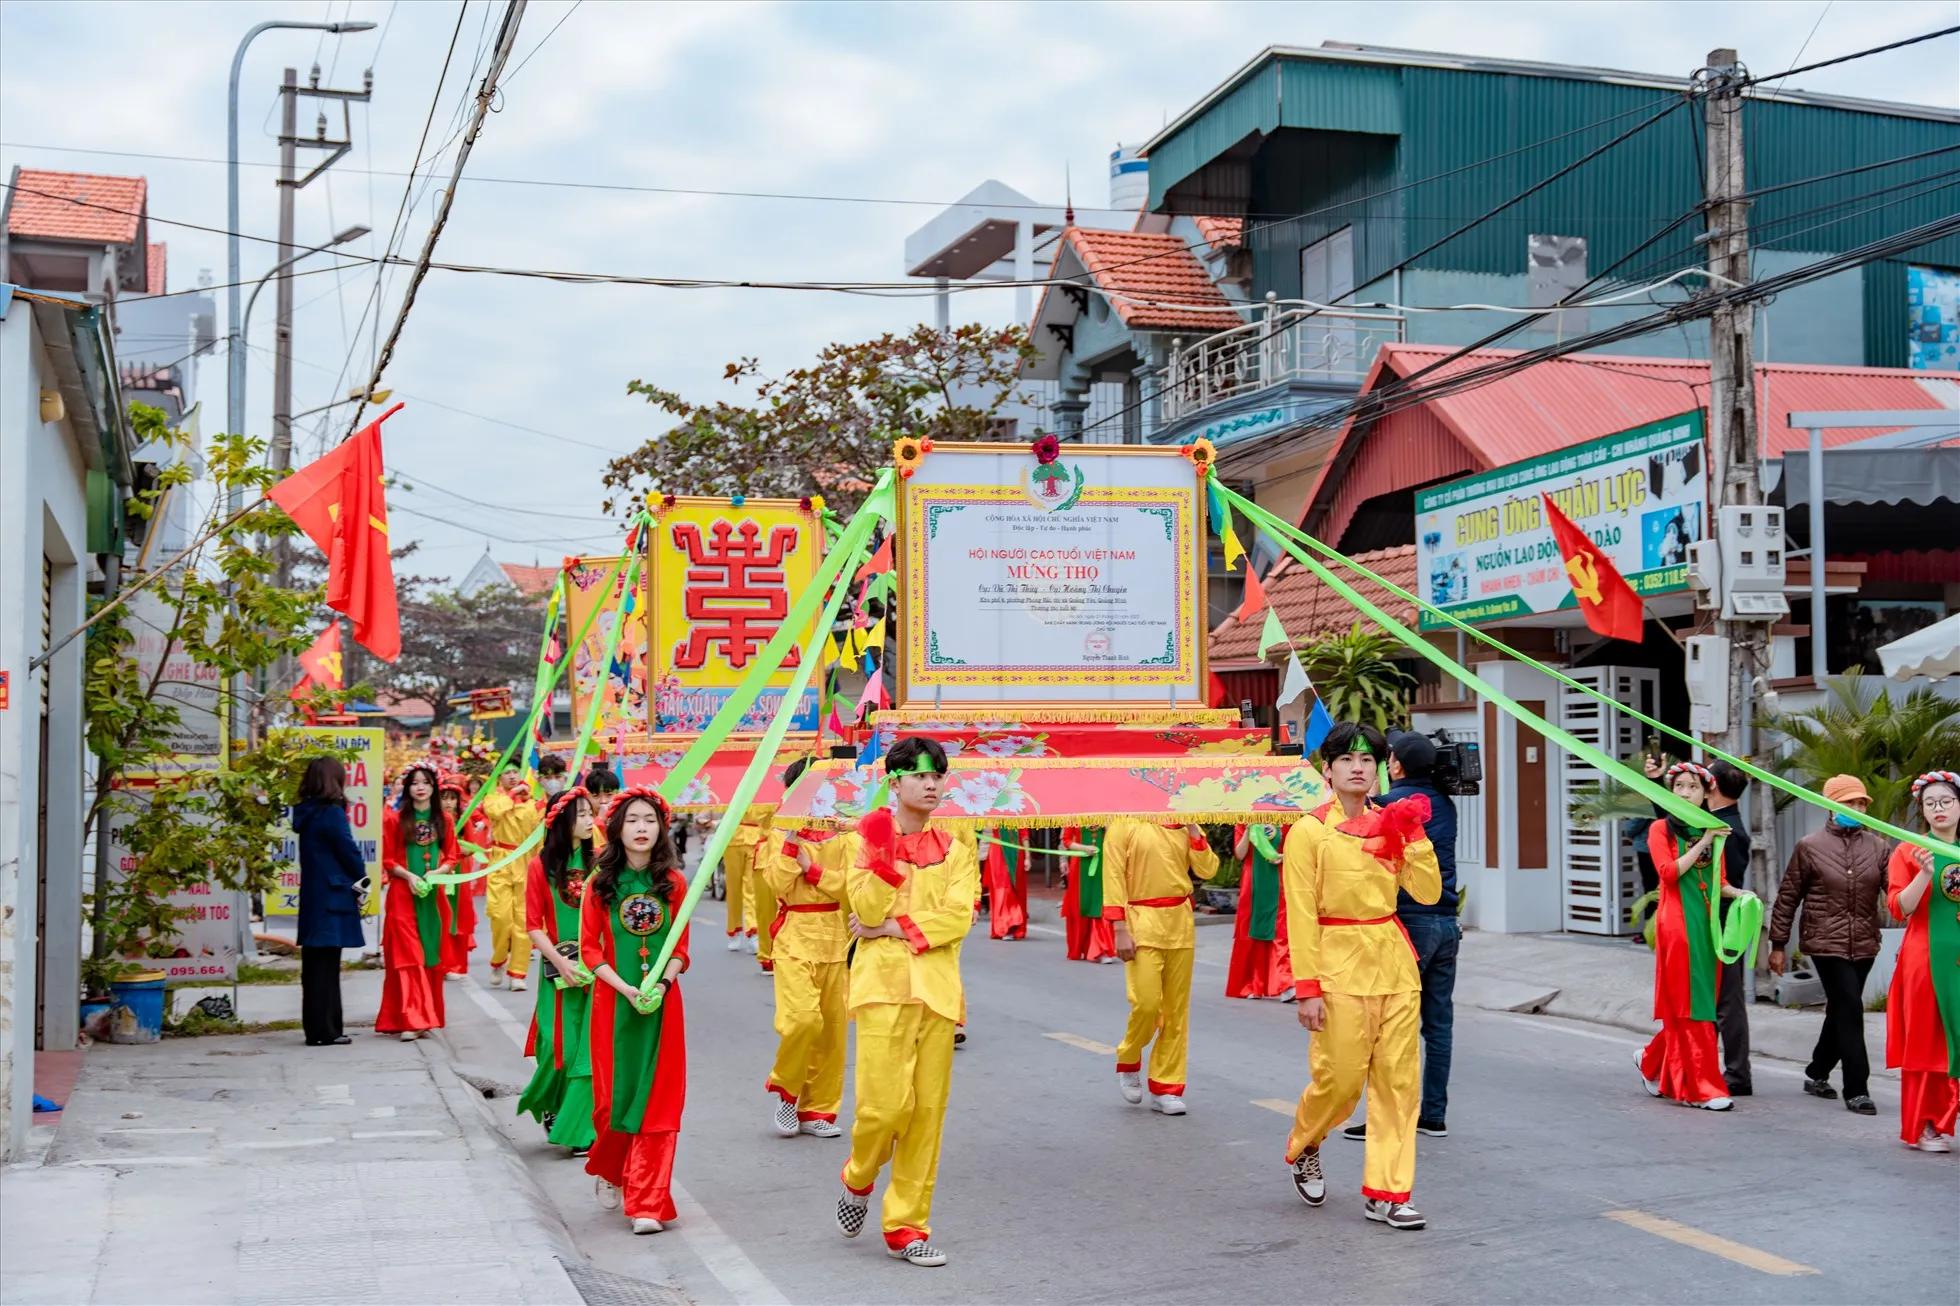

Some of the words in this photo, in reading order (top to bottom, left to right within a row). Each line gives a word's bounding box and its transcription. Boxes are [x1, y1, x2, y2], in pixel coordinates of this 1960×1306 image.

[1455, 508, 1499, 548] CUNG
[1503, 494, 1541, 536] ỨNG
[1604, 467, 1646, 518] LỰC
[969, 547, 988, 560] HỘI
[991, 548, 1027, 560] NGƯỜI
[1030, 550, 1055, 560] CAO
[1057, 546, 1081, 560] TUỔI
[1084, 549, 1107, 562] VIỆT
[1110, 551, 1136, 560] NAM
[1476, 543, 1512, 573] NGUỒN
[1514, 545, 1535, 565] LAO
[1007, 562, 1058, 579] MỪNG
[1063, 565, 1099, 581] THỌ
